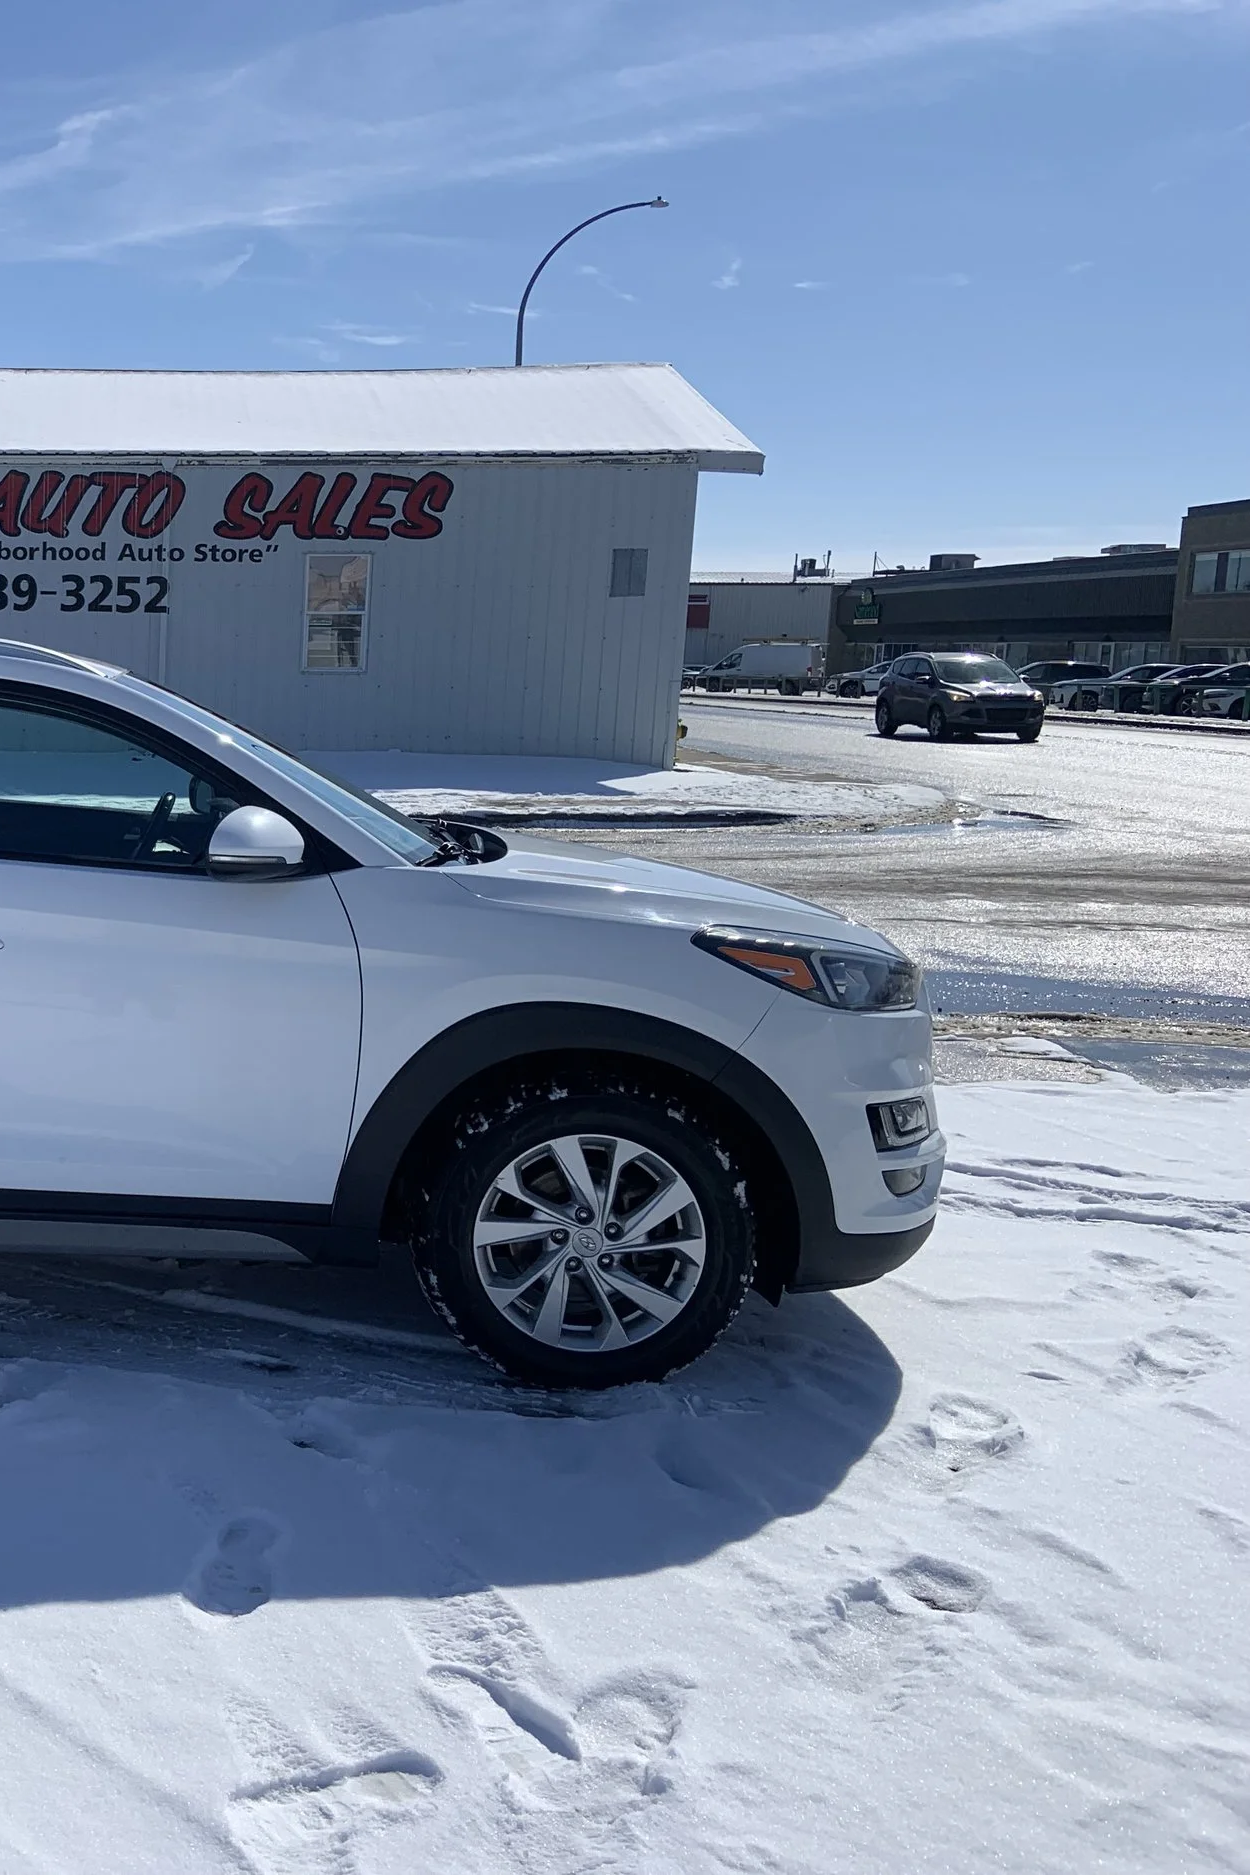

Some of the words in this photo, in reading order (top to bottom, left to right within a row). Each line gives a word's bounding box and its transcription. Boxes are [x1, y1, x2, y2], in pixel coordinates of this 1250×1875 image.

[213, 470, 454, 540] SALES
[117, 543, 185, 562] Auto
[193, 543, 279, 563] Store"
